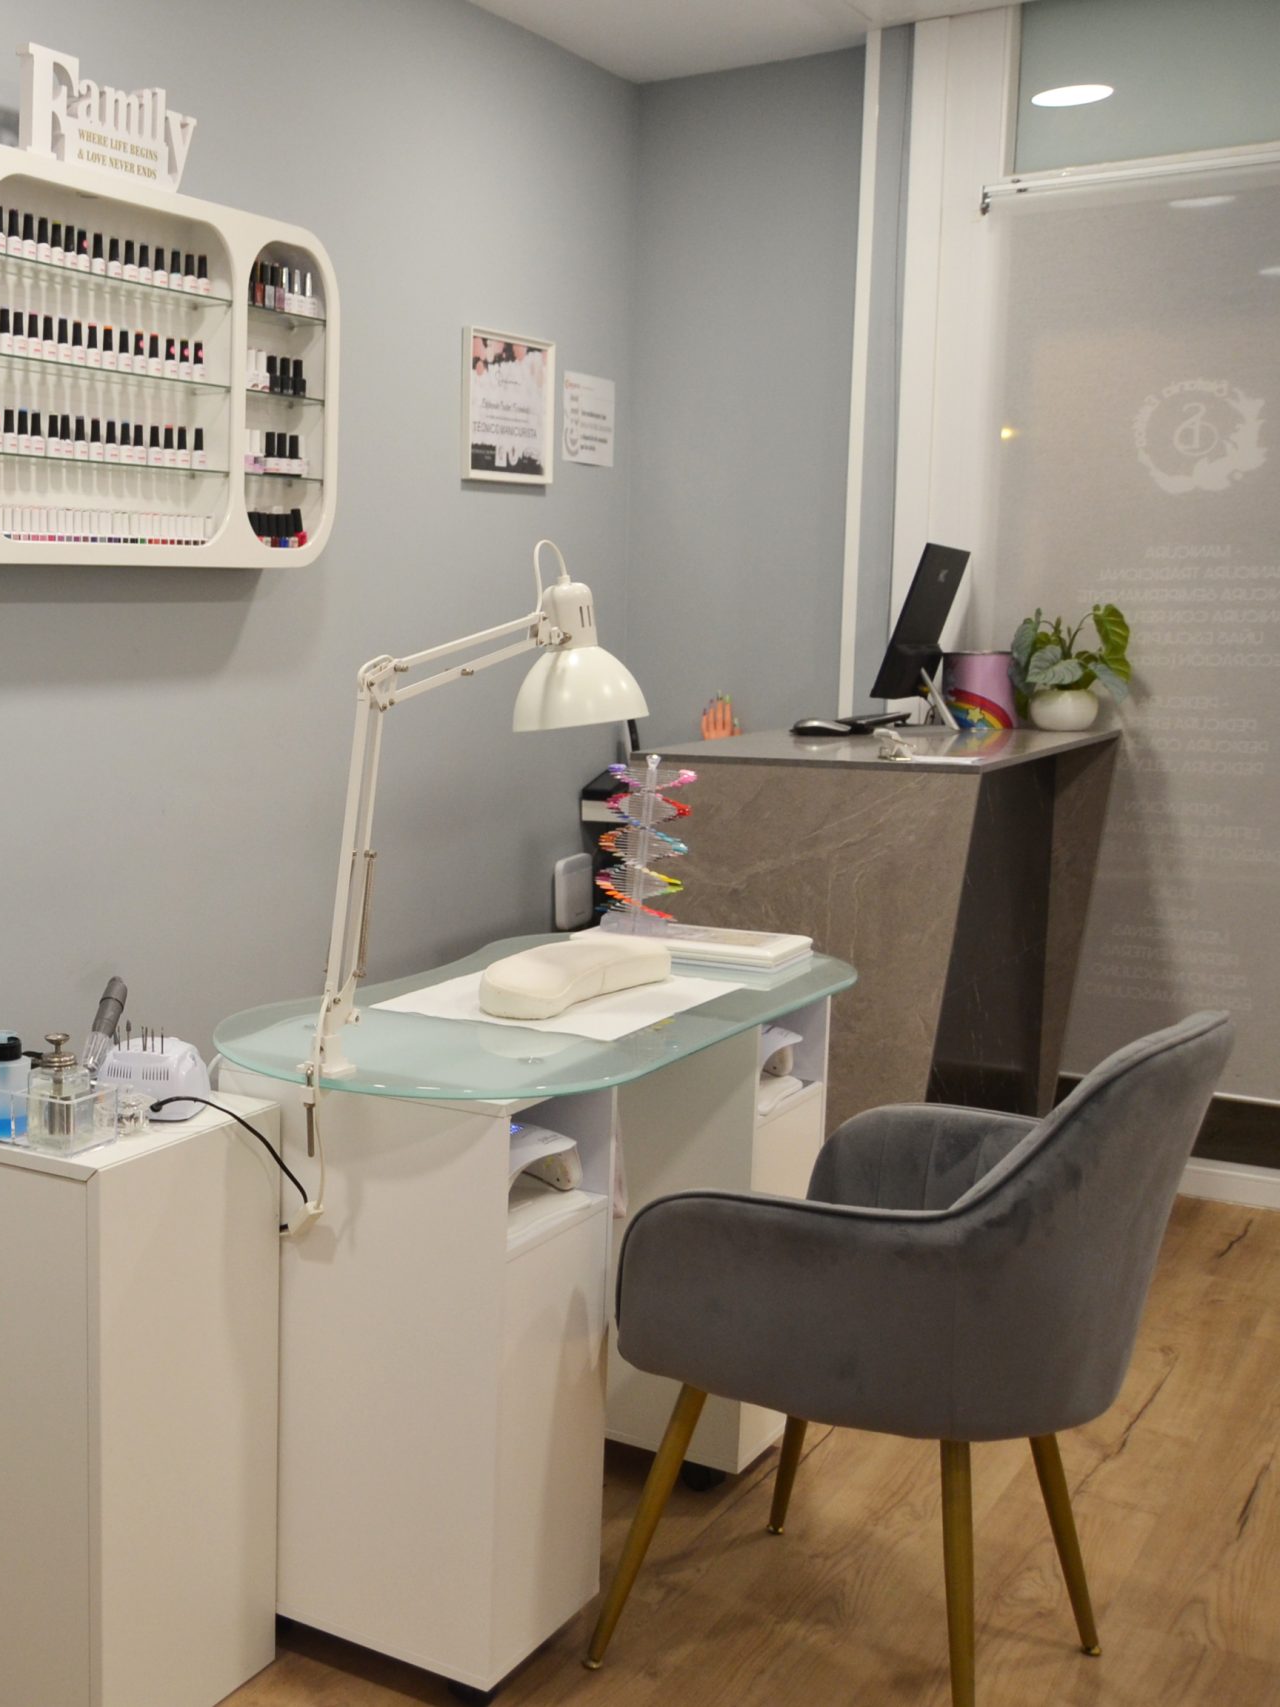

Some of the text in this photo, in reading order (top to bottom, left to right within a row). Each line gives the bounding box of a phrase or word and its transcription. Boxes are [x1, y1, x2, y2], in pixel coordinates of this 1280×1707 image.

[22, 41, 197, 193] Family
[78, 128, 159, 163] WHERE LIFE BEGINS
[77, 148, 158, 181] & LOVE NEVER ENDS
